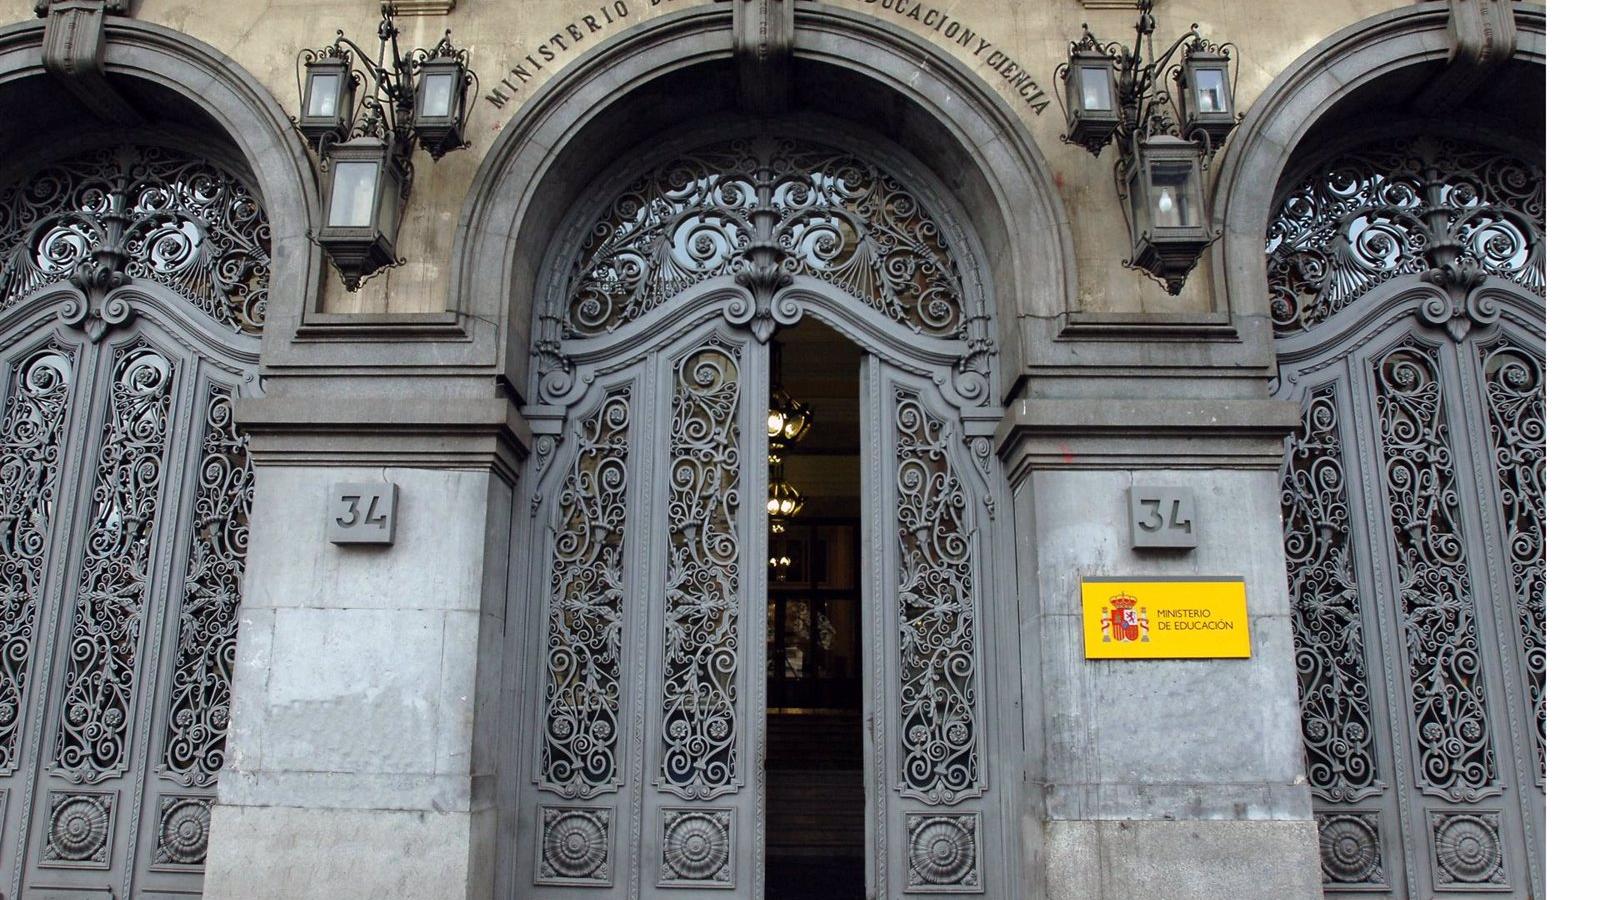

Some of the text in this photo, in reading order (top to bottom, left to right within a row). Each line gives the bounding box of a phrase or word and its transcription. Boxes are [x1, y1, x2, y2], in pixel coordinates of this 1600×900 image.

[485, 0, 629, 109] MINISTERIO
[857, 0, 976, 47] UCACION
[986, 50, 1050, 116] CIENCIA
[335, 495, 387, 529] 34
[1138, 499, 1192, 534] 34
[1157, 609, 1211, 618] MINISTERIO
[1158, 619, 1234, 630] DE EDUCACIÓN
